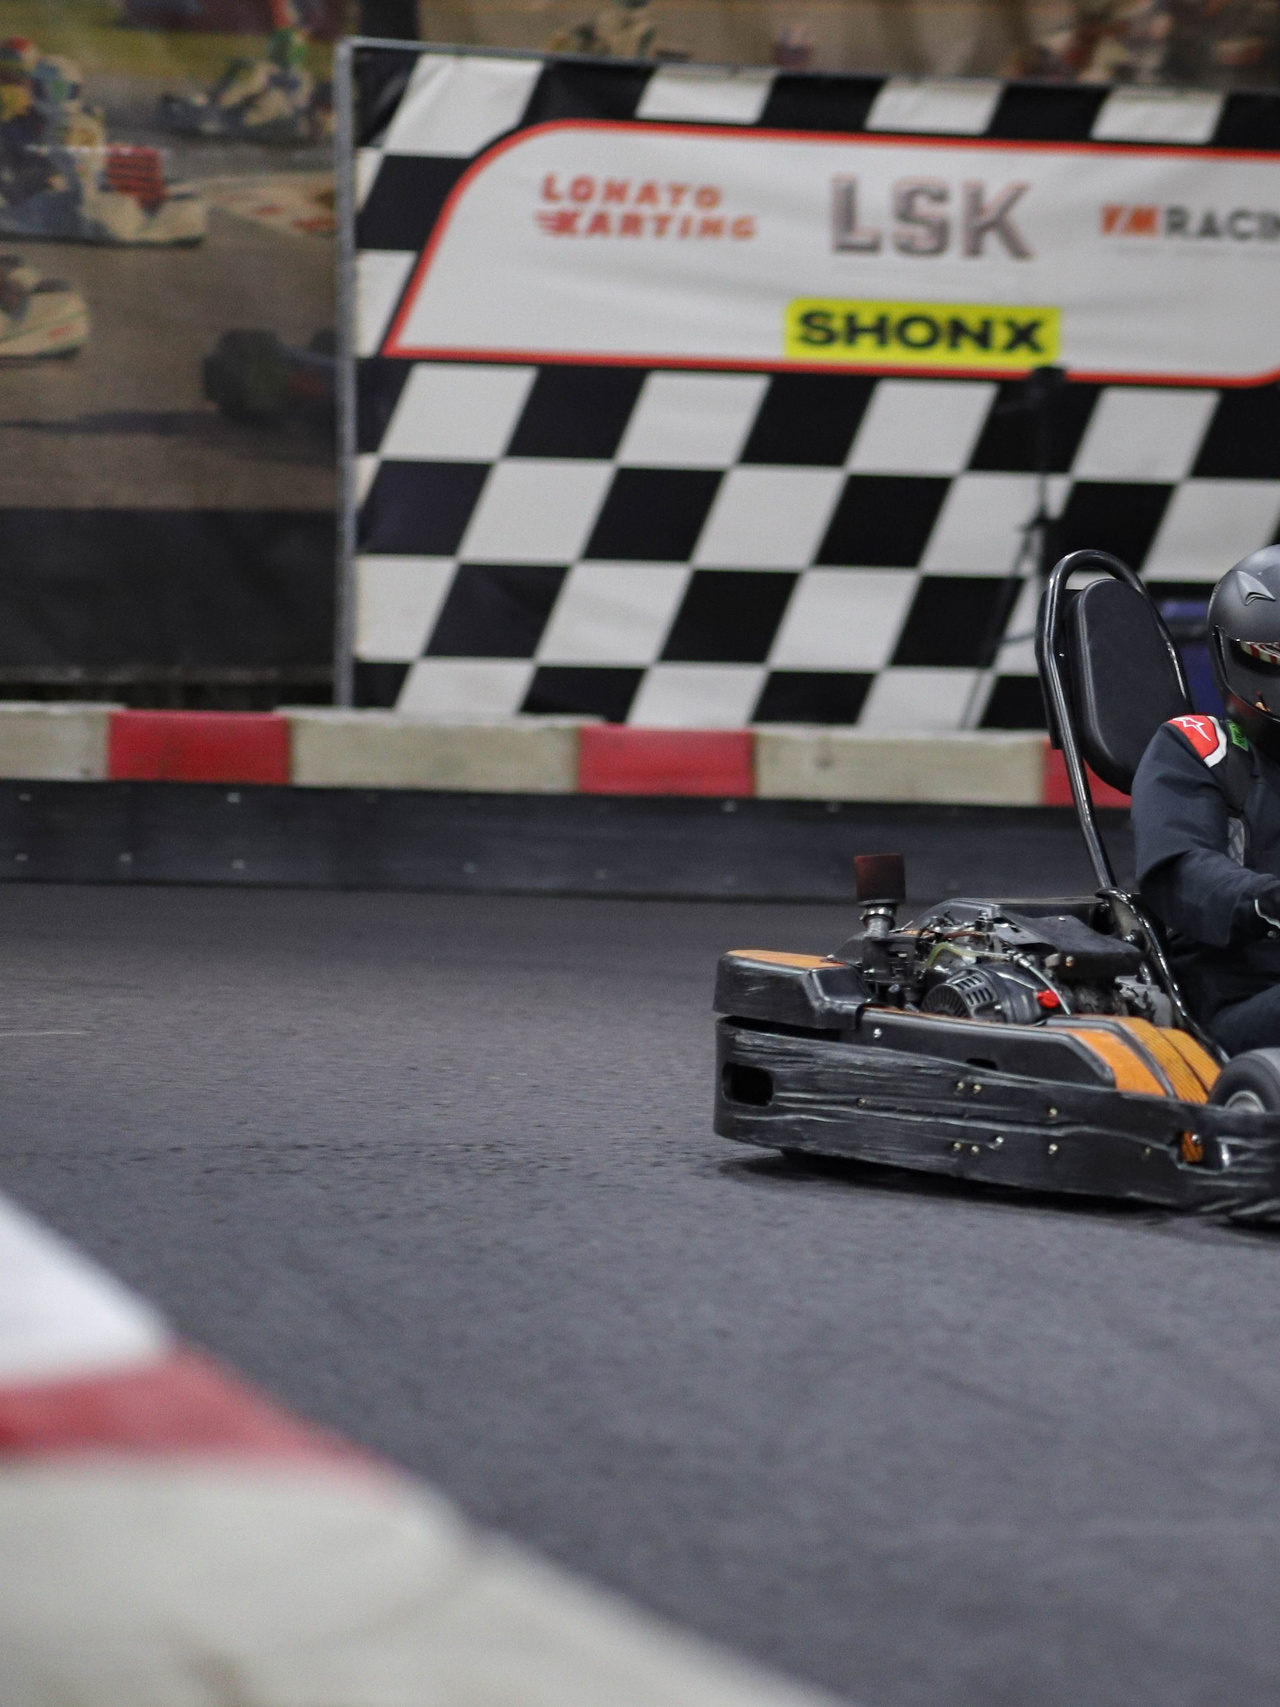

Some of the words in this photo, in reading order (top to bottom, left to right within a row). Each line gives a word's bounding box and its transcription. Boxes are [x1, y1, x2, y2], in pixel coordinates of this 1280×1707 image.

[541, 173, 722, 209] LONATO
[535, 210, 757, 239] KARTING
[830, 173, 1033, 261] LSK
[799, 310, 1043, 354] SHONX
